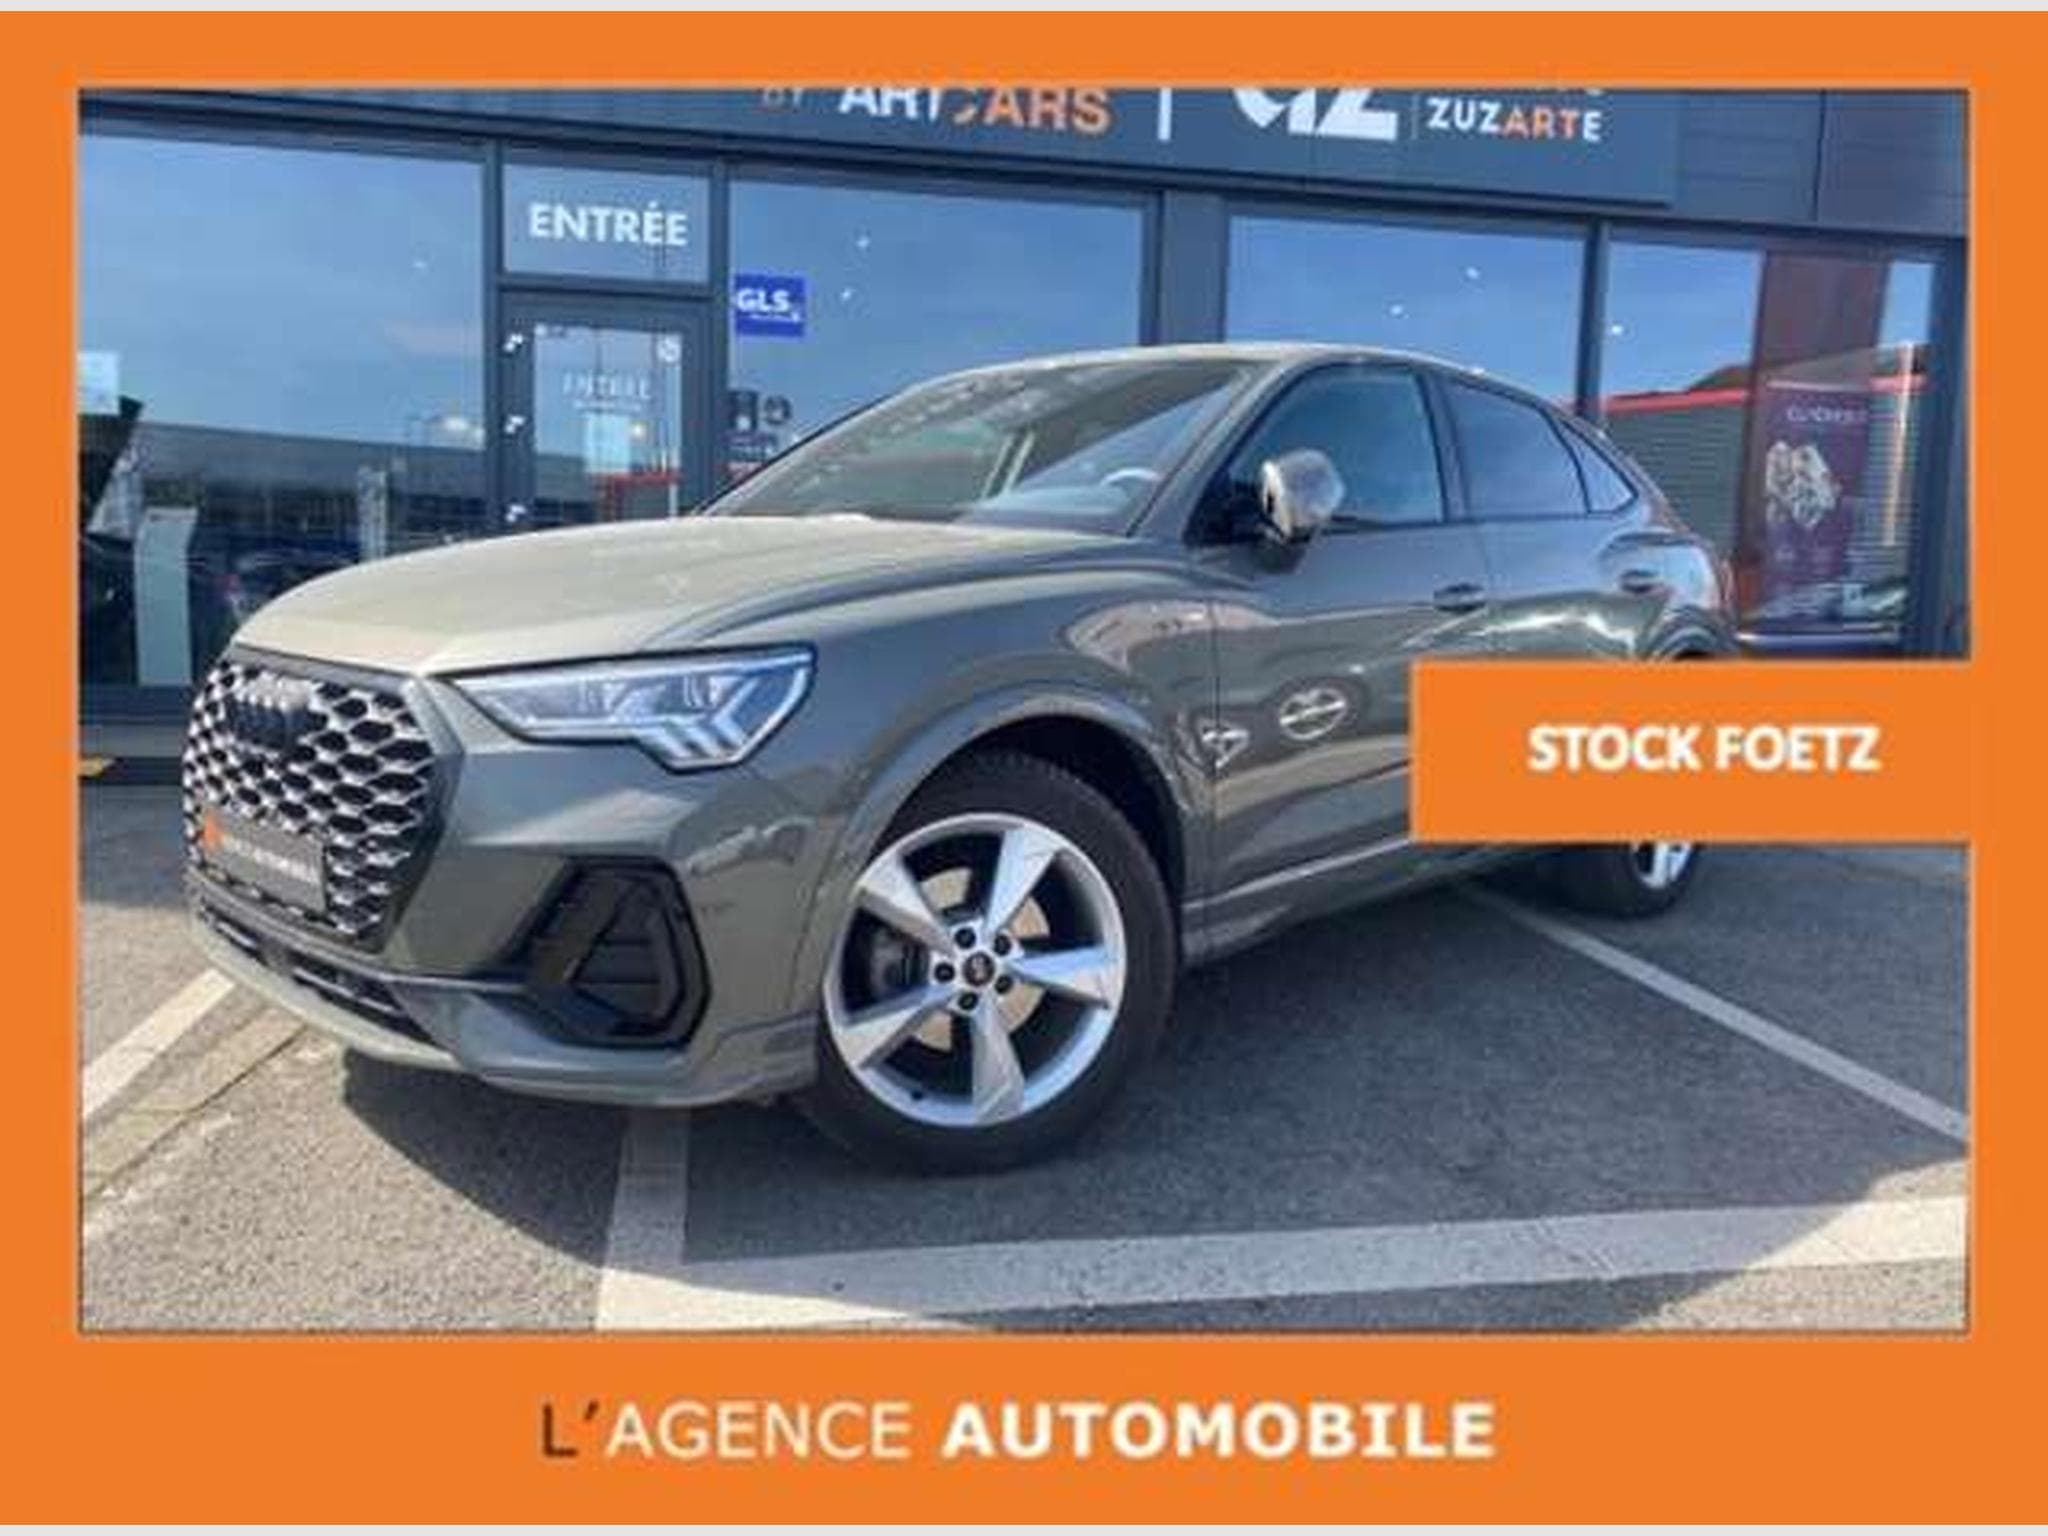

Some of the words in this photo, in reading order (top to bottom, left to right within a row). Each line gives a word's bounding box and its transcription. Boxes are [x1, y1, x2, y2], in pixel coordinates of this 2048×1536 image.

[1427, 97, 1602, 142] ZUZARTE
[529, 201, 688, 246] ENTRÉE
[737, 287, 790, 313] GLS
